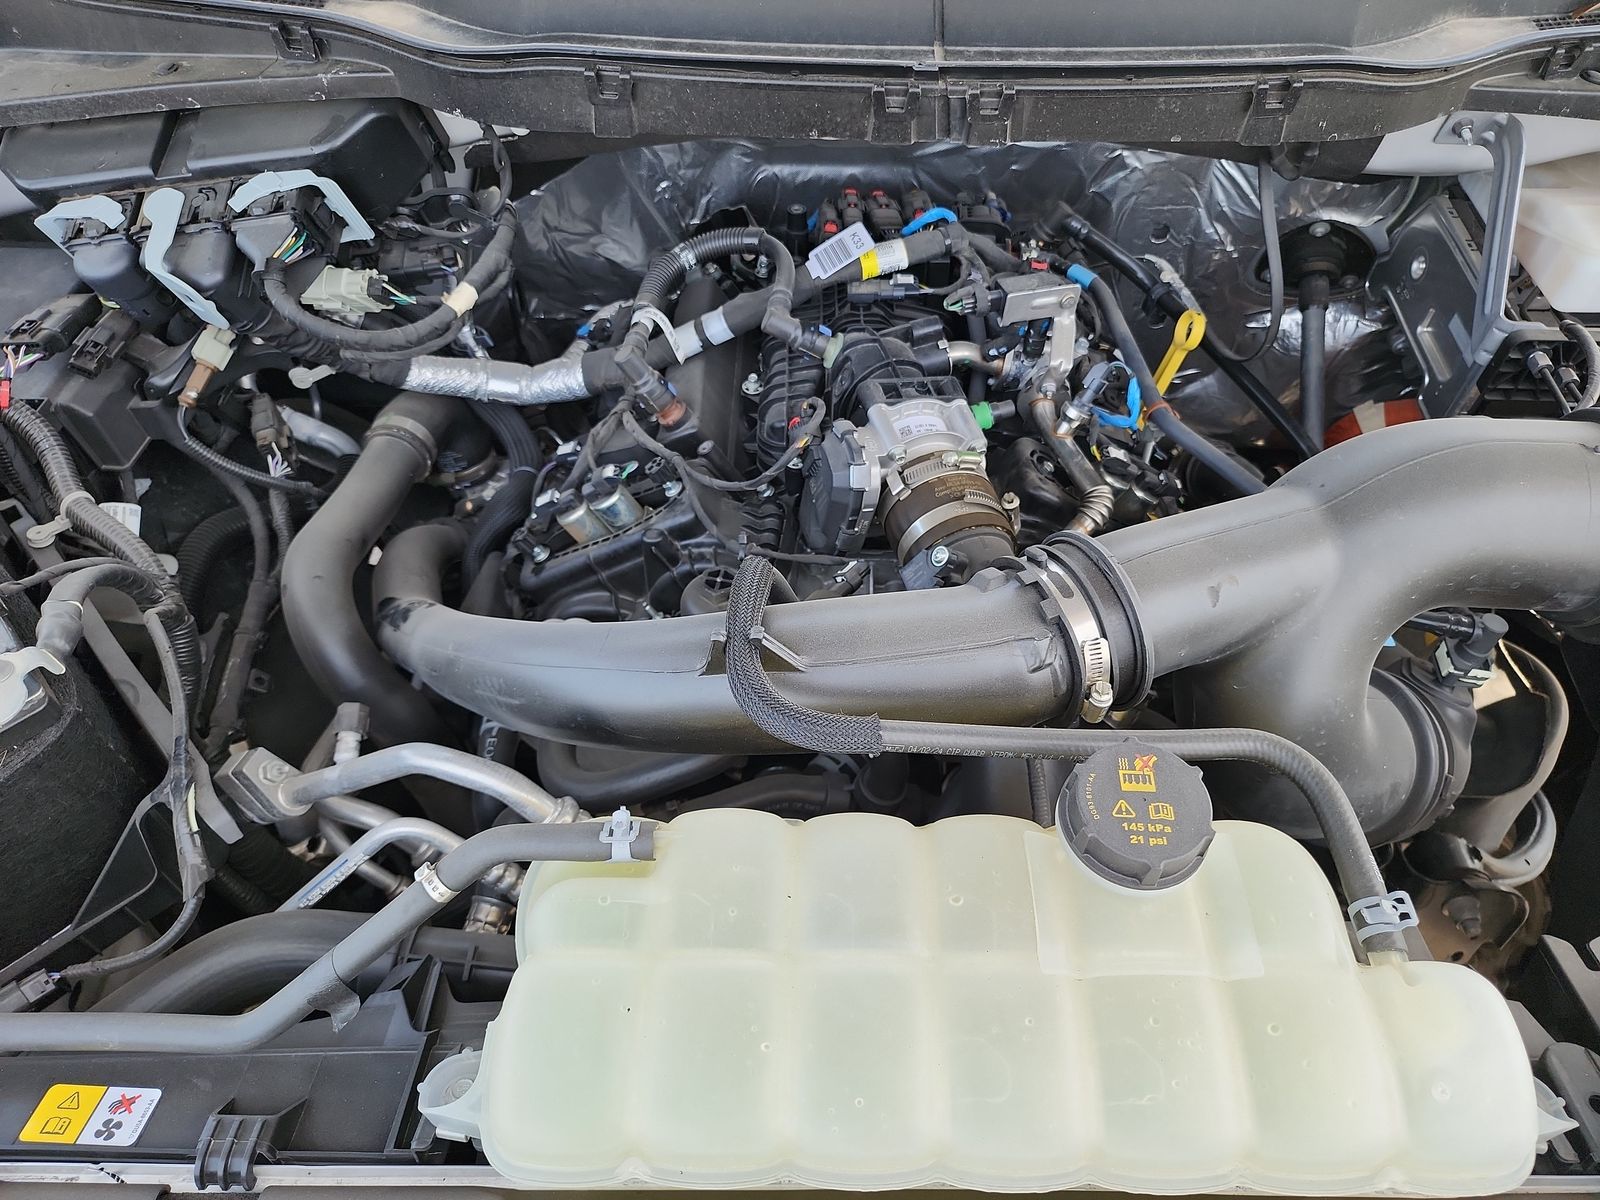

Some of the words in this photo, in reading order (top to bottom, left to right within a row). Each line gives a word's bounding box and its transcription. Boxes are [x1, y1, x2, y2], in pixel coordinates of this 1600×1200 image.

[849, 232, 865, 250] K33
[1121, 822, 1145, 832] 145
[1147, 822, 1172, 833] kPa
[1129, 835, 1144, 844] 21
[1149, 835, 1168, 846] psi
